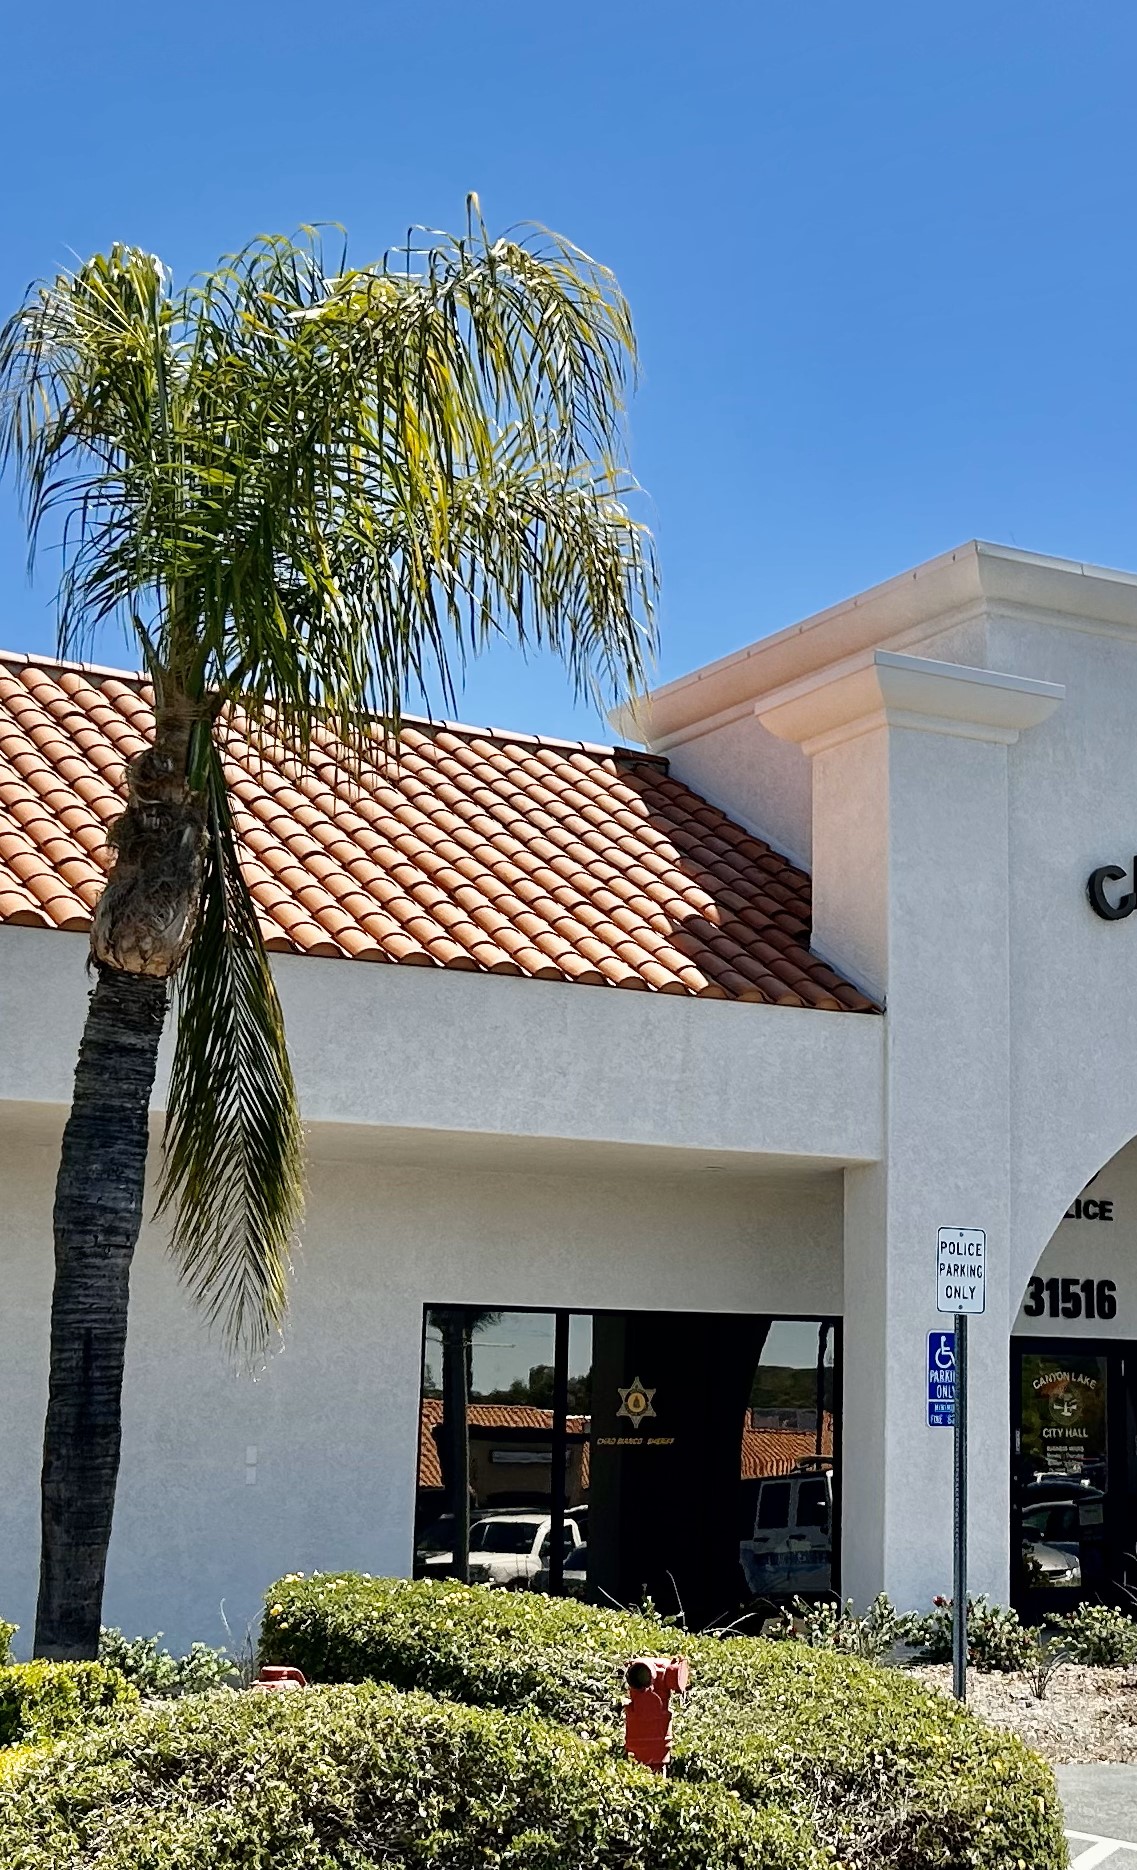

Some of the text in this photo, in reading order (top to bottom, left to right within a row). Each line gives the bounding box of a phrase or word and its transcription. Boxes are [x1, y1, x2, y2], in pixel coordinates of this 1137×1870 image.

[940, 1241, 983, 1257] POLICE
[939, 1262, 983, 1279] PARKING
[945, 1285, 976, 1300] ONLY
[1024, 1275, 1117, 1320] 31516
[1032, 1371, 1097, 1390] CANYON LAKE
[1042, 1427, 1089, 1439] CITY HALL
